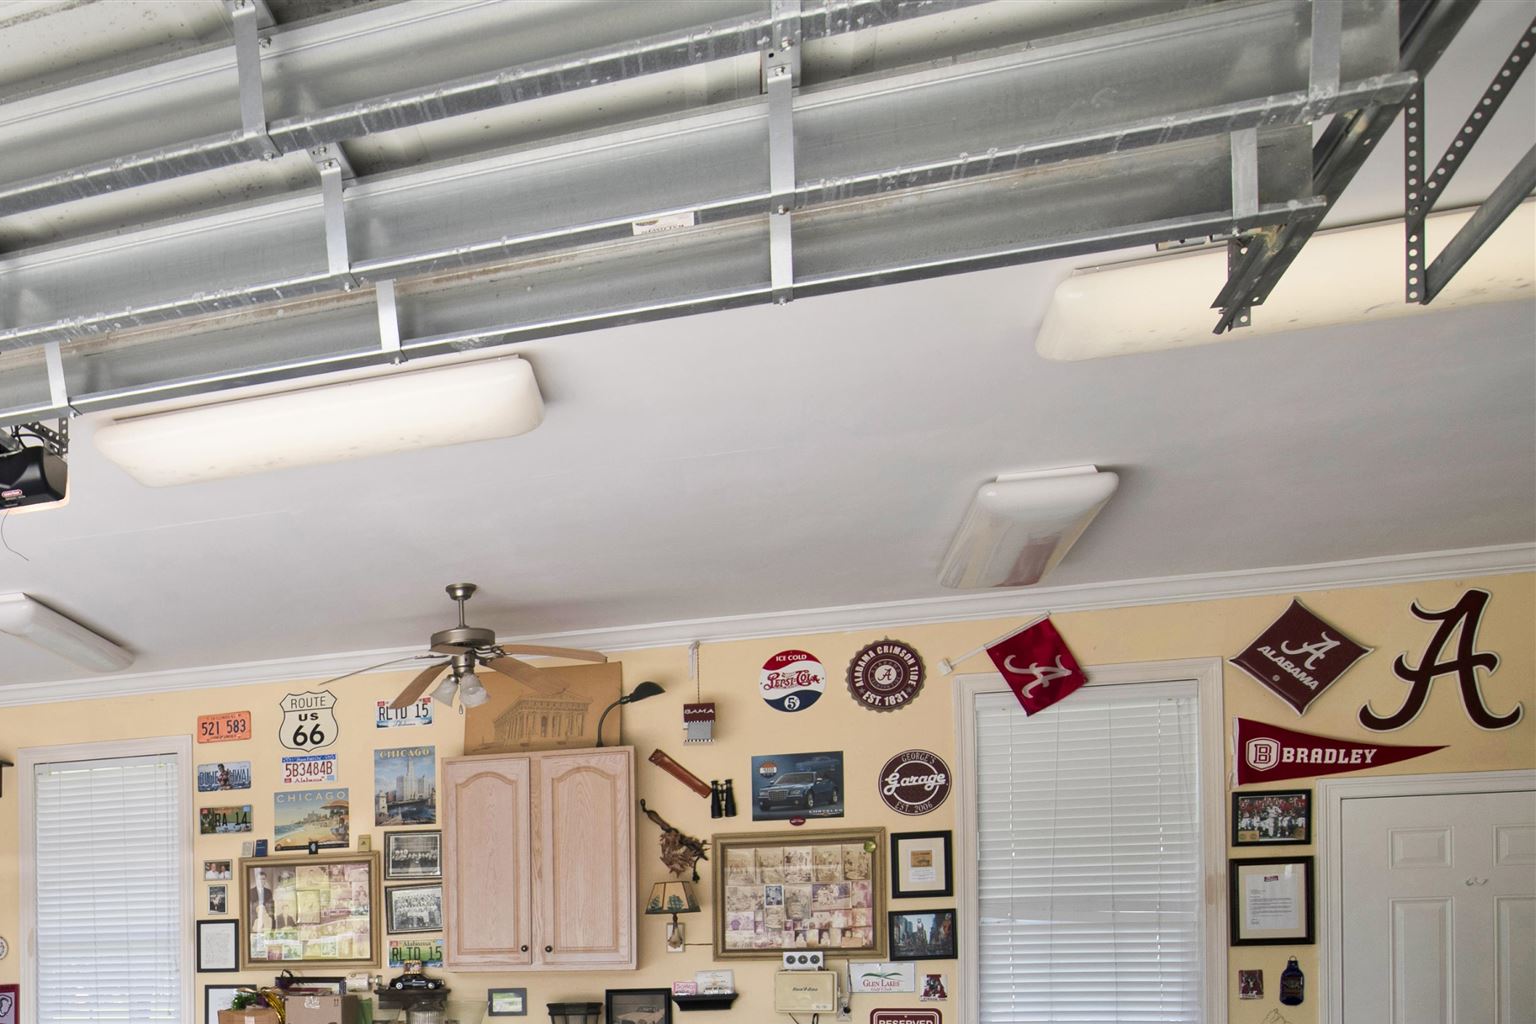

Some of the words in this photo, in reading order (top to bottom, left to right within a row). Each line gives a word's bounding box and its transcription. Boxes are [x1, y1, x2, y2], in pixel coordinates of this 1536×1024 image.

[854, 650, 875, 687] ALABAMA
[877, 645, 916, 665] CRIMSON
[908, 666, 919, 687] TIDE
[1256, 645, 1319, 690] ALABAMA
[290, 696, 325, 709] ROUTE
[863, 691, 882, 706] EST.
[884, 691, 908, 706] 1831
[298, 712, 319, 721] US
[415, 703, 429, 718] 15
[202, 721, 220, 736] 521
[226, 719, 246, 734] 583
[293, 723, 325, 746] 66
[380, 749, 430, 758] CHICAGO
[1282, 747, 1378, 764] BRADLEY
[884, 772, 946, 796] Garage
[276, 791, 346, 802] CHICAGO
[429, 946, 442, 960] 15
[863, 979, 879, 987] GLEN
[881, 979, 900, 987] LAKES
